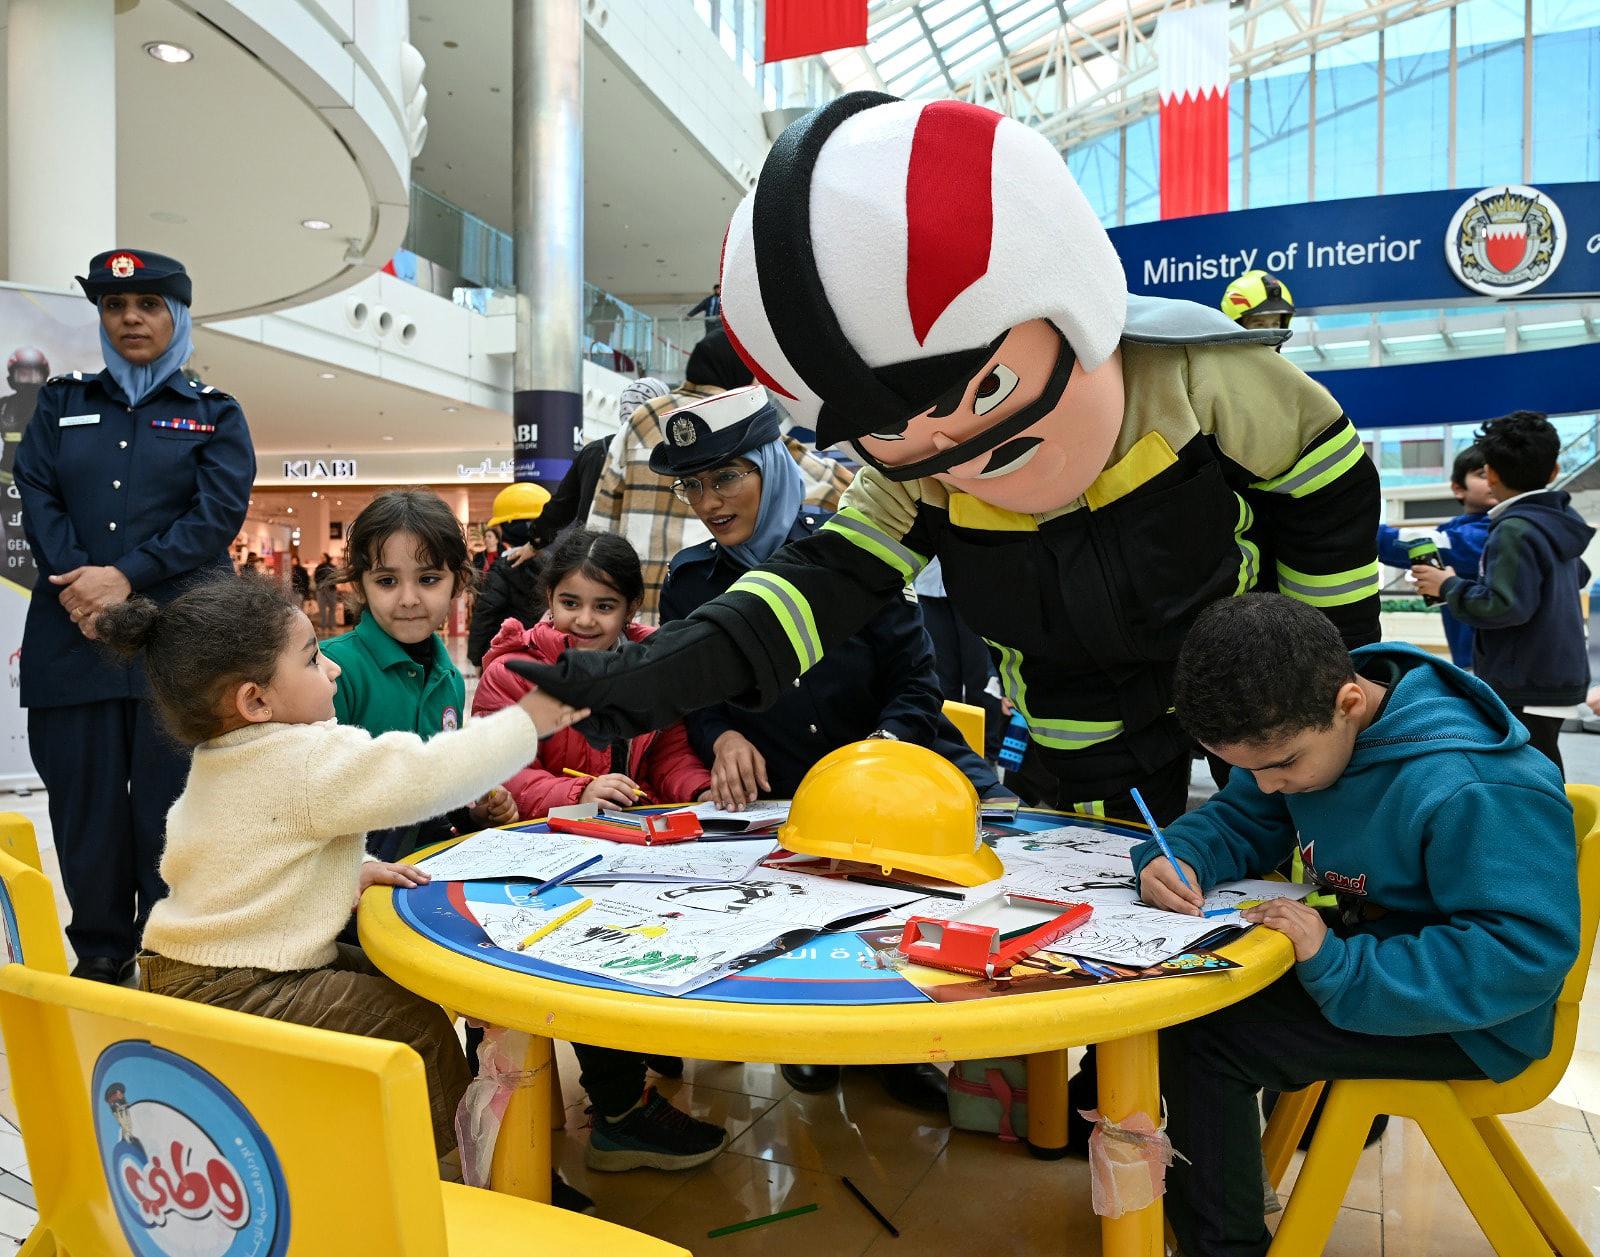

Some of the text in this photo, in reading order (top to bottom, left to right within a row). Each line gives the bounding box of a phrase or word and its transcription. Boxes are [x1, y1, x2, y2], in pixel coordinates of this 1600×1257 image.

[1143, 235, 1422, 286] Ministry of Interior
[283, 460, 357, 479] KIABI
[124, 1140, 244, 1221] وطني
